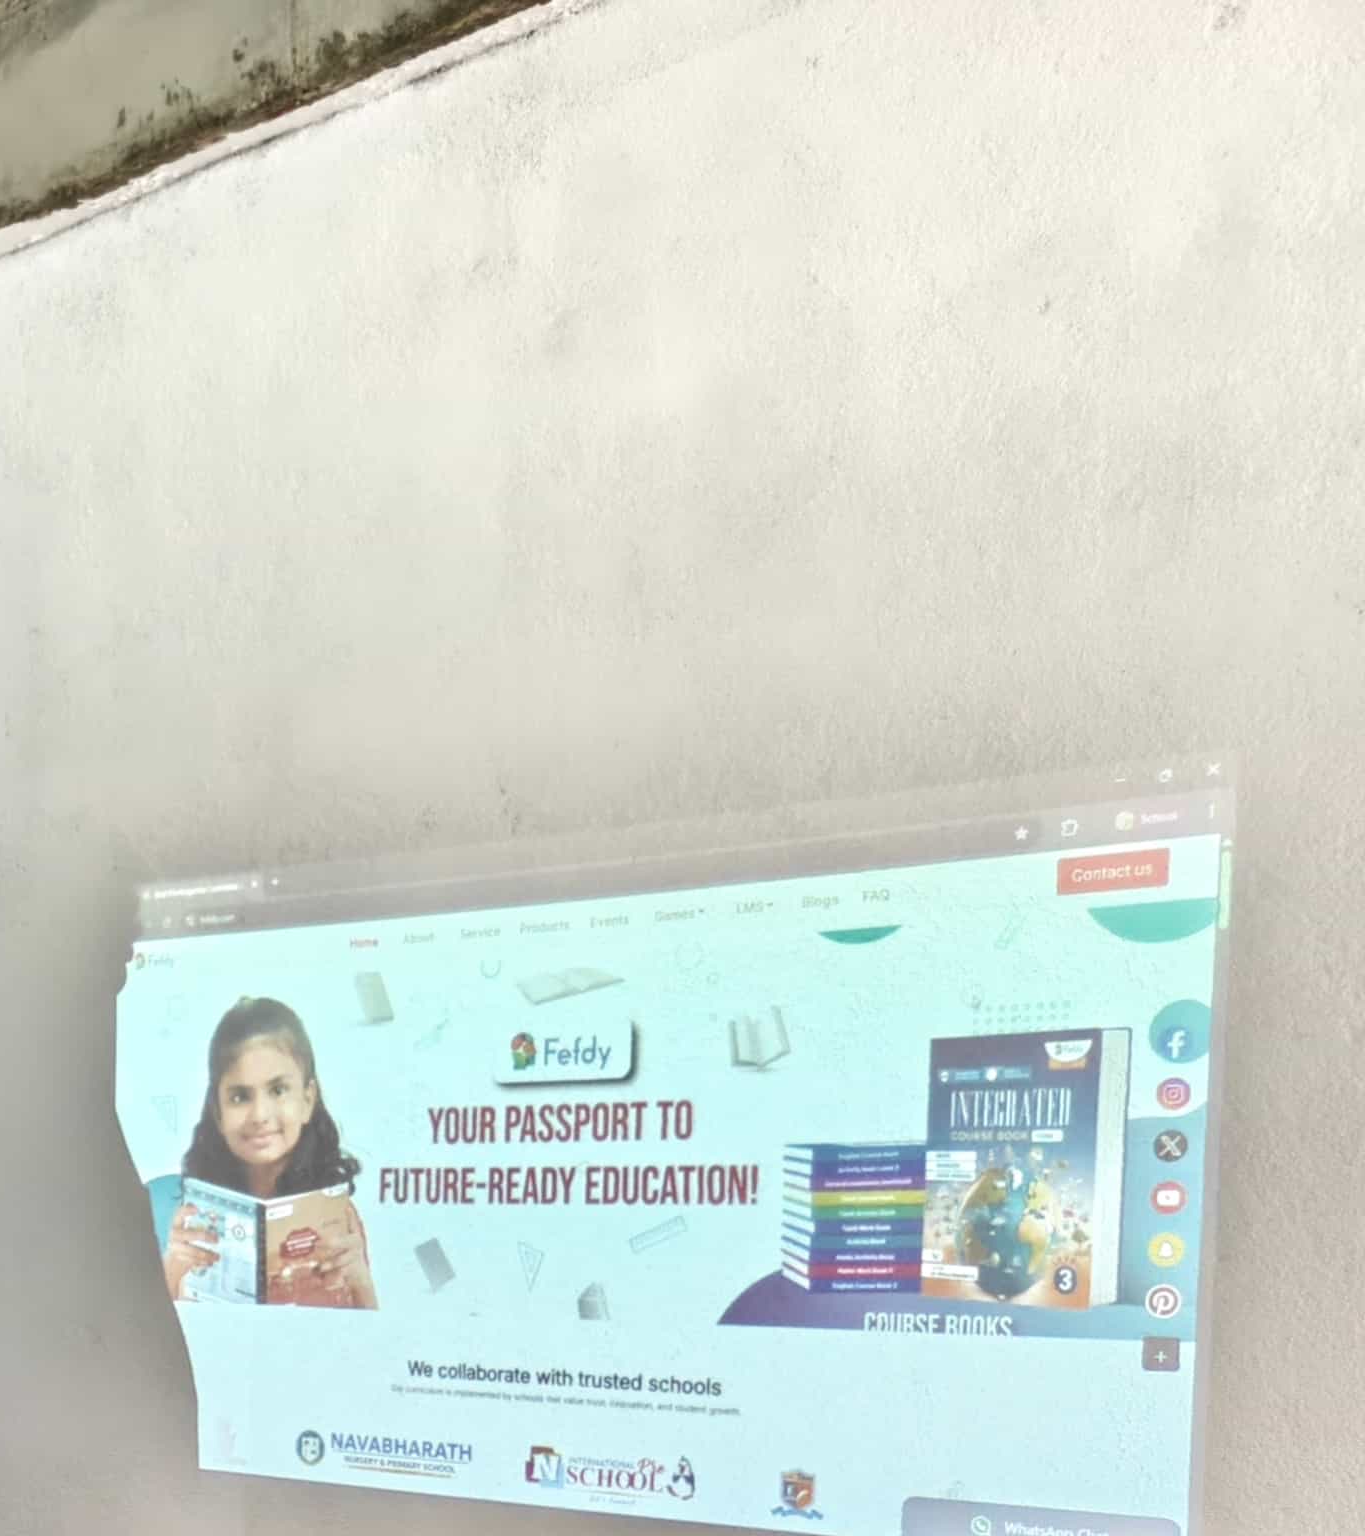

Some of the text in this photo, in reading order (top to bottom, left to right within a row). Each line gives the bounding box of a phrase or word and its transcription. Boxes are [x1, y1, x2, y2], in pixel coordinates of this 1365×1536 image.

[1071, 863, 1153, 882] Contact us
[350, 888, 891, 949] Home About Service Products Events Games LMS Blogs FAQ
[543, 1035, 612, 1069] Fefdy
[428, 1099, 693, 1145] YOUR PASSPORT TO
[950, 1087, 1072, 1129] INTEGRATED
[950, 1130, 994, 1142] COURSE
[996, 1130, 1029, 1141] BOOK
[379, 1164, 759, 1206] FUTURE-READY EDUCATION!
[1058, 1269, 1074, 1292] 3
[863, 1311, 1013, 1337] COURSE BOOKS
[407, 1360, 723, 1396] We collaborate with trusted schools
[330, 1431, 473, 1462] NAVABHARATH
[344, 1454, 379, 1466] NURSERY
[387, 1458, 421, 1470] PRIMARY
[423, 1463, 457, 1474] SCHOOL
[568, 1455, 635, 1469] INTERNATIONAL
[566, 1464, 664, 1493] SCHOOL
